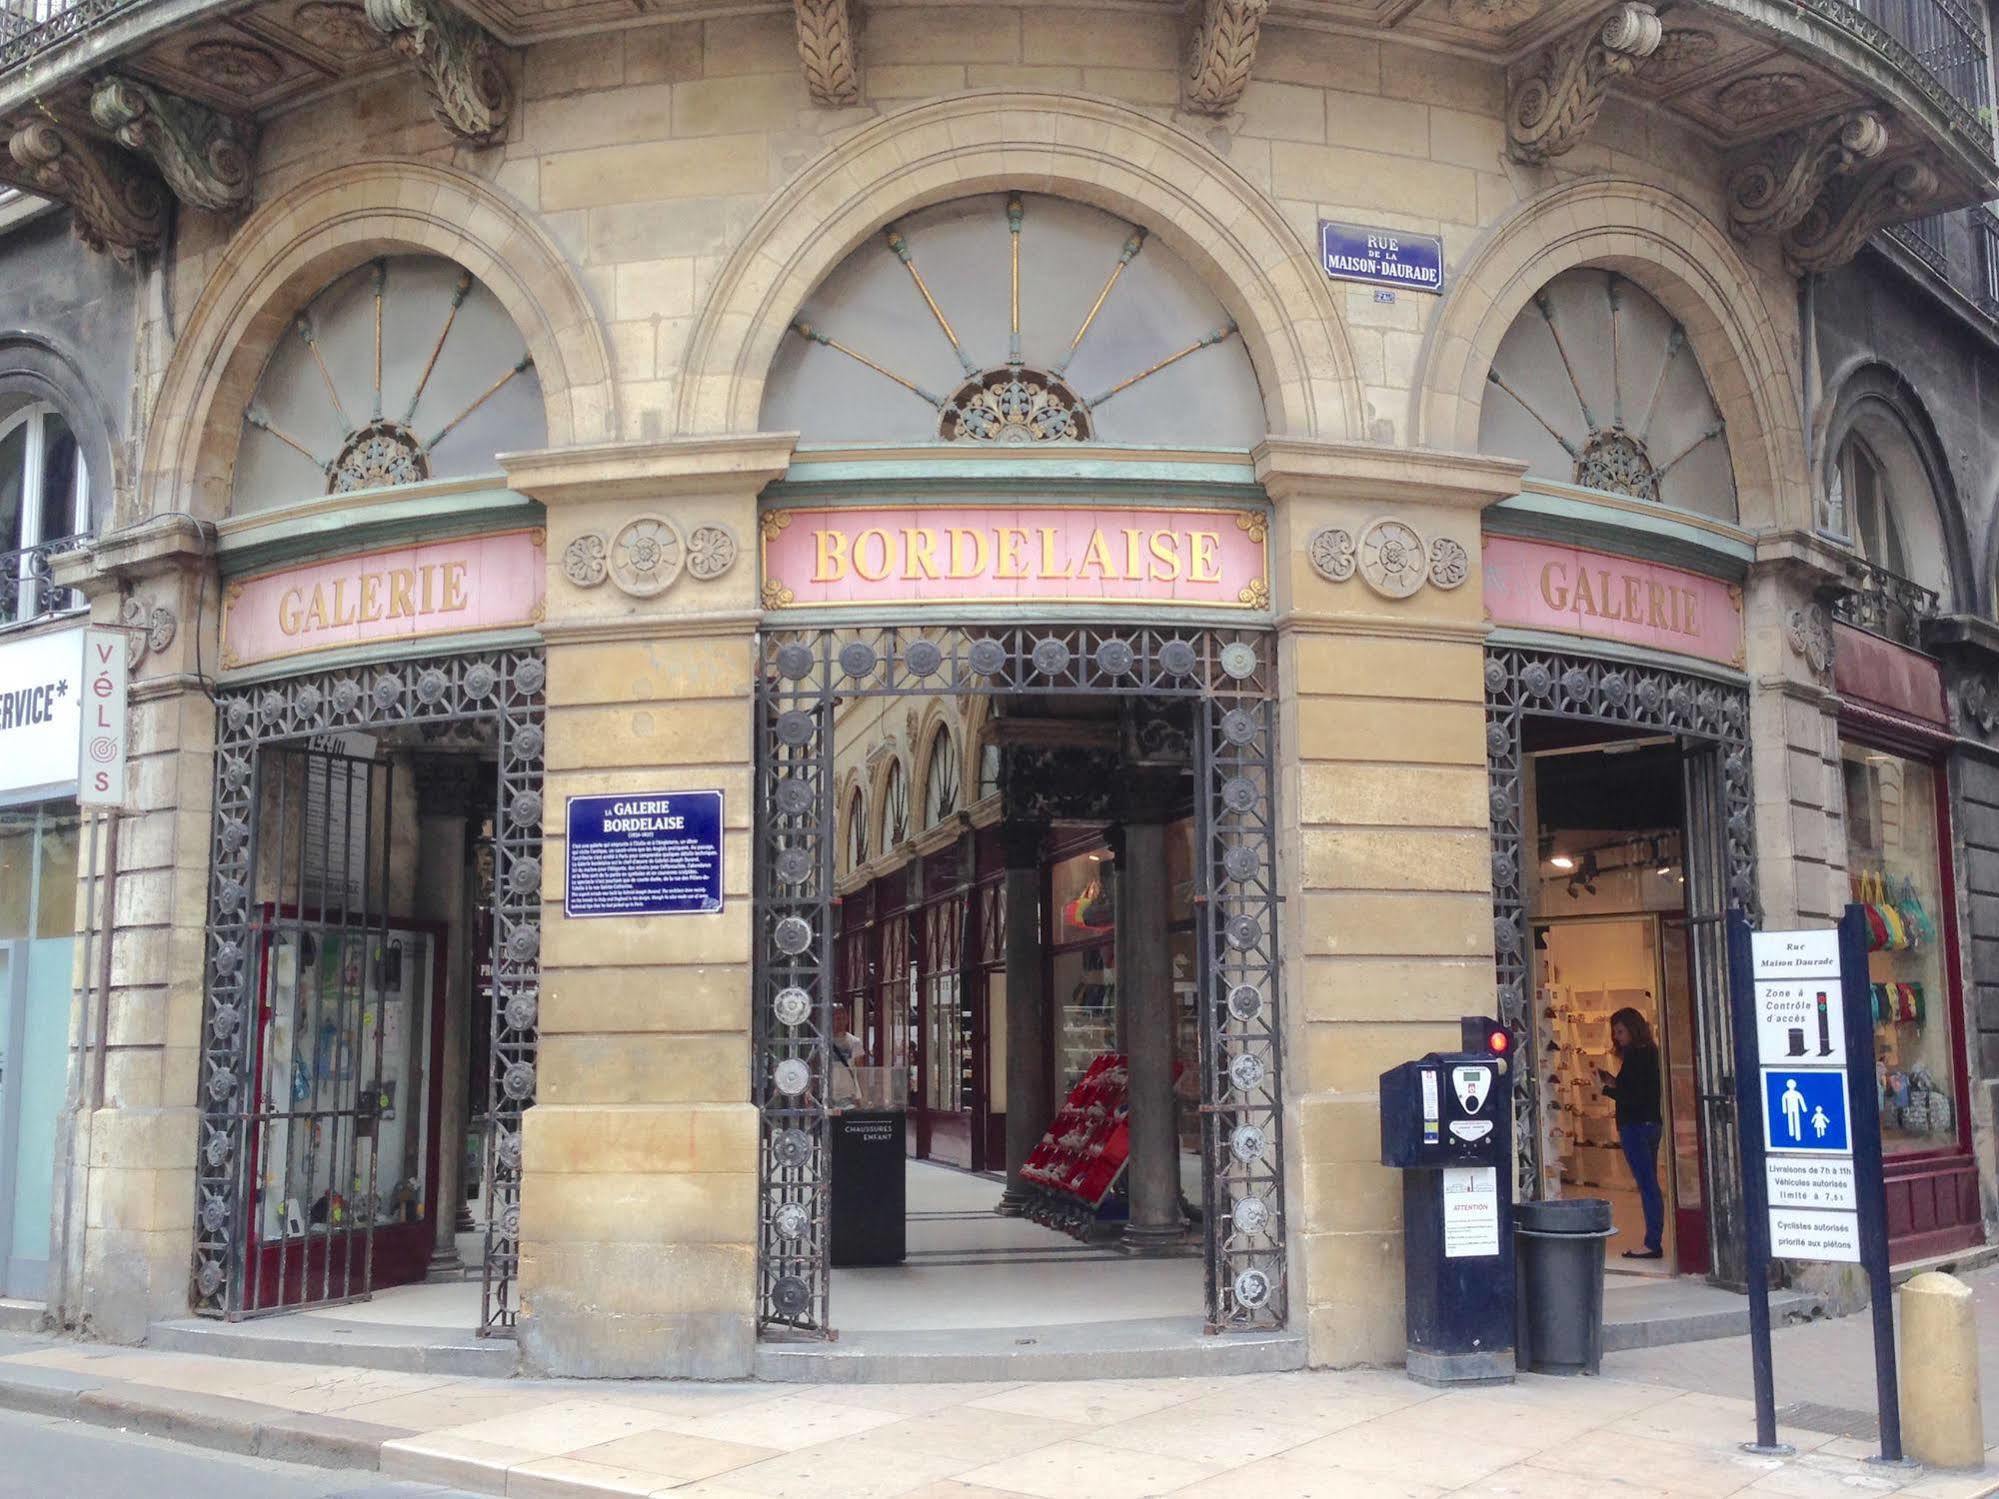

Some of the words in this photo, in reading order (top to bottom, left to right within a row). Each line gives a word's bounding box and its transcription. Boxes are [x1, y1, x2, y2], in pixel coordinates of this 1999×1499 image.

[1367, 235, 1399, 251] RUE
[1368, 250, 1381, 259] DE
[1386, 252, 1398, 261] LA
[1329, 254, 1437, 282] MAISON-DAURADE
[811, 526, 1224, 584] BORDELAISE
[278, 559, 469, 636] GALERIE
[1539, 560, 1702, 638] GALERIE
[604, 809, 613, 817] LA
[614, 801, 670, 815] GALERIE
[604, 816, 685, 832] BORDELAISE
[1786, 942, 1807, 951] Rue
[1761, 958, 1793, 967] Maison
[1795, 957, 1834, 967] Daurade
[1765, 989, 1791, 998] Zone
[1798, 988, 1804, 998] à
[1766, 1000, 1812, 1011] Contrôle
[1766, 1013, 1807, 1023] d'accès
[844, 1125, 892, 1134] CHAUSSURES
[863, 1133, 892, 1141] ENFANT
[1768, 1165, 1807, 1174] Livraisons
[1808, 1166, 1819, 1174] de
[1832, 1167, 1838, 1175] à
[1774, 1178, 1811, 1187] Véhicules
[1812, 1179, 1848, 1188] autorisés
[1780, 1191, 1807, 1200] limité
[1814, 1192, 1819, 1200] à
[1453, 1203, 1489, 1212] ATTENTION
[1777, 1221, 1812, 1231] Cyclistes
[1813, 1222, 1850, 1232] autorisés
[1778, 1236, 1806, 1247] priorité
[1807, 1239, 1821, 1248] aux
[1823, 1239, 1852, 1249] piétons
